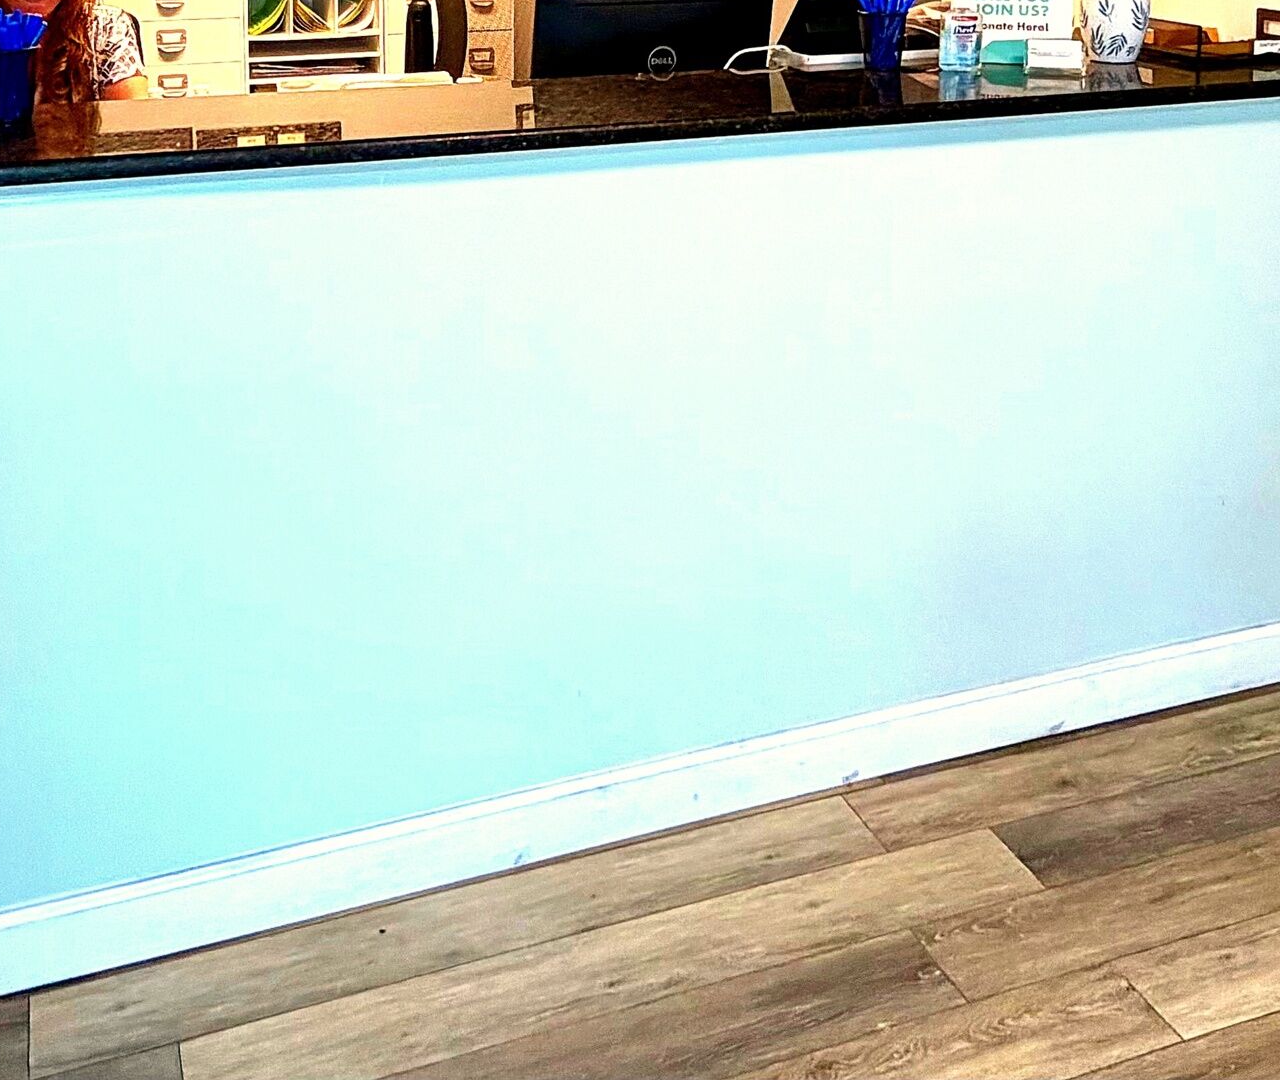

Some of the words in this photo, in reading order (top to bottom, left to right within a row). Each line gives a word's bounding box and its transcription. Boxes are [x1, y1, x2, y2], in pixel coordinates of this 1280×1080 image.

[1018, 4, 1049, 17] US?
[981, 22, 1013, 30] onate
[651, 57, 673, 65] DELL
